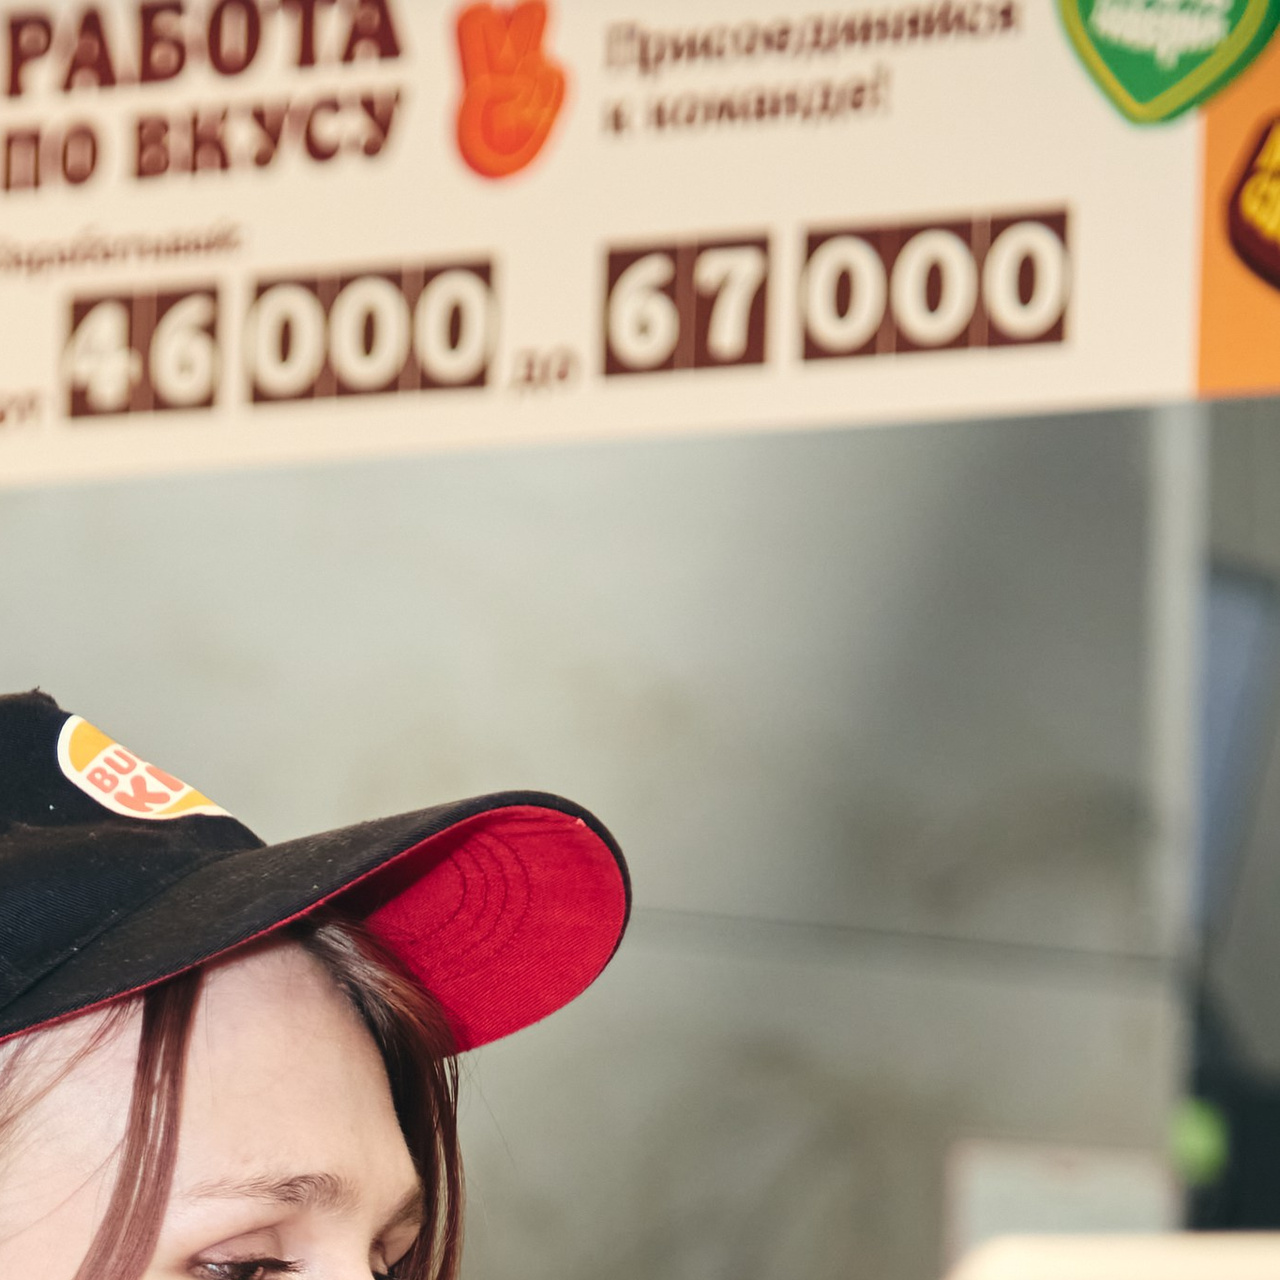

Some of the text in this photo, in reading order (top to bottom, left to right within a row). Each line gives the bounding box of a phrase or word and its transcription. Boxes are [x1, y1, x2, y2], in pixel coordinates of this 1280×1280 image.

[6, 0, 401, 96] РАБОТА
[5, 90, 401, 190] ПО ВКУСУ
[61, 292, 220, 412] 46
[244, 267, 496, 398] 000
[607, 250, 768, 370] 67
[801, 221, 1071, 353] 000
[86, 747, 146, 794] BU
